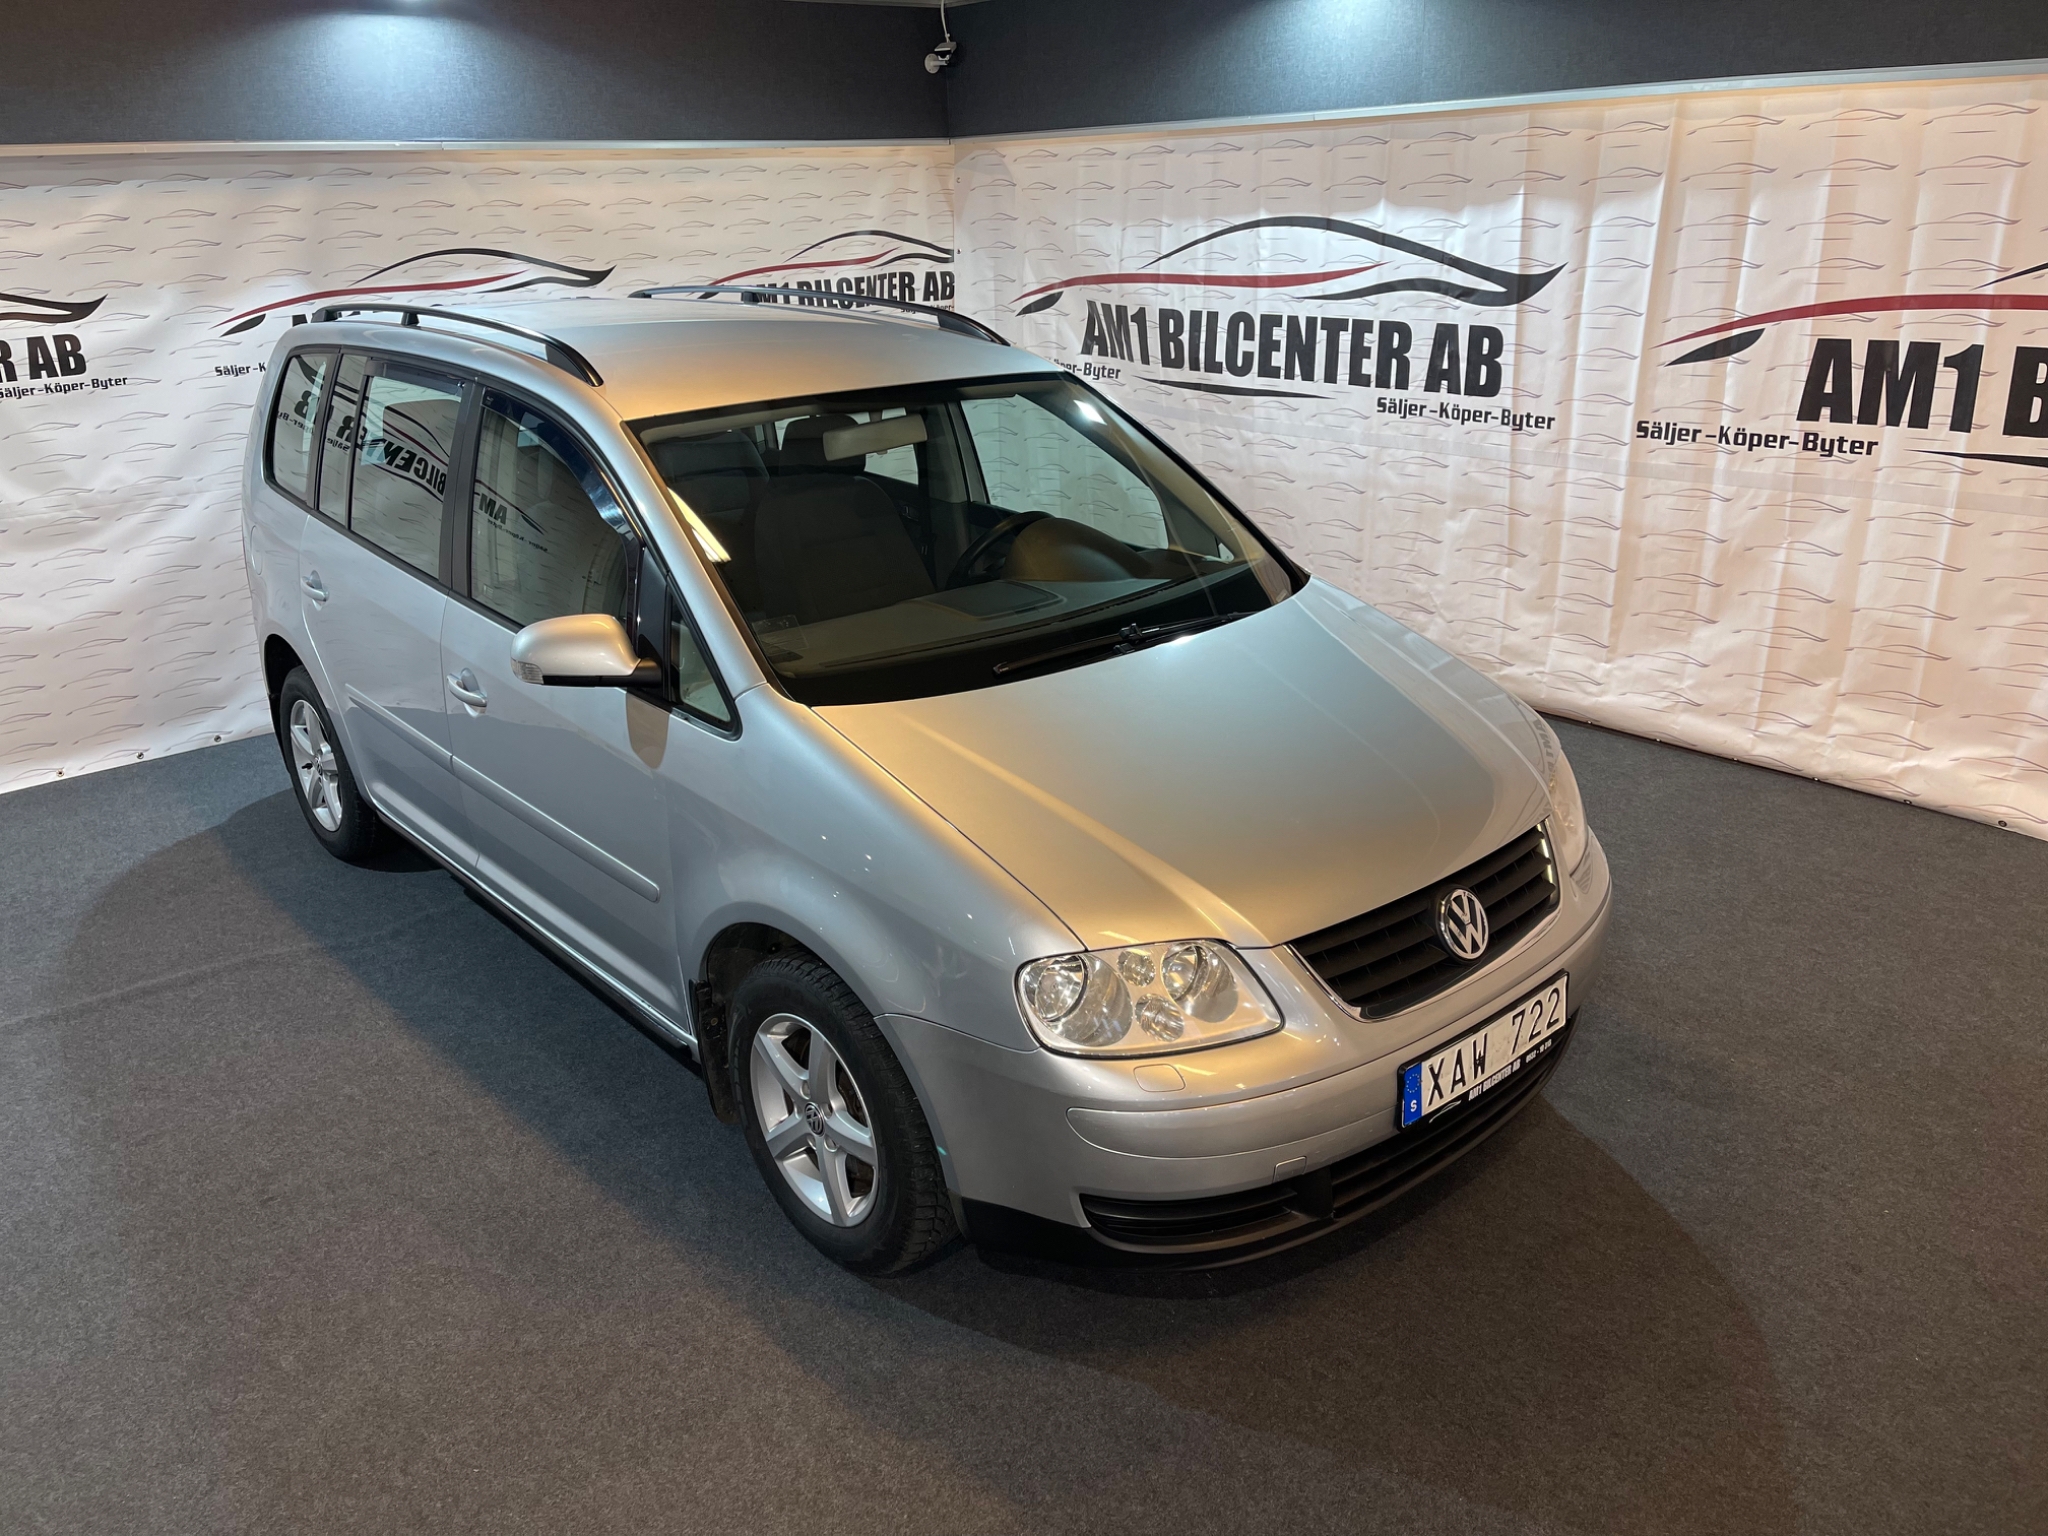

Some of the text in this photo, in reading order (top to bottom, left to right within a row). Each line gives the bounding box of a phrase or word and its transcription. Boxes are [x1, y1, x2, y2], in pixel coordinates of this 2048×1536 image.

[797, 271, 916, 309] BILCENTER
[923, 270, 955, 302] AB
[26, 333, 87, 380] AB
[1080, 299, 1504, 398] AM1 BILCENTER AB
[1796, 337, 1985, 434] AM1
[1427, 987, 1561, 1107] XAW 722
[1410, 1099, 1417, 1113] S
